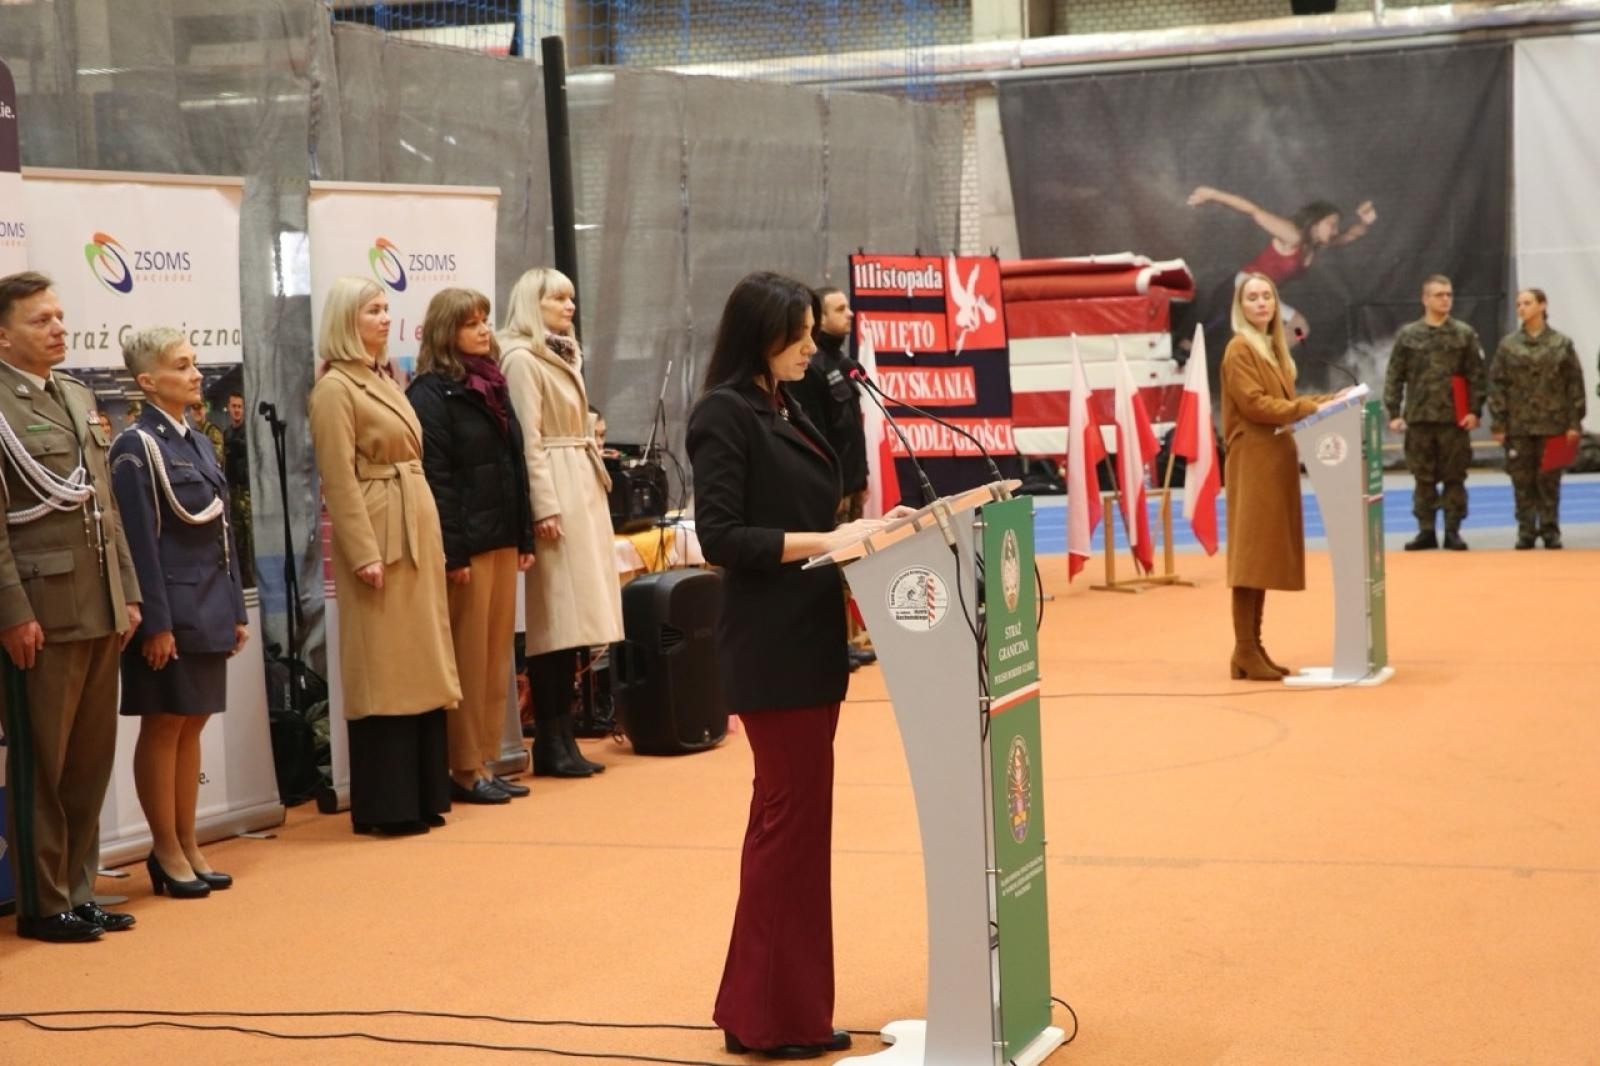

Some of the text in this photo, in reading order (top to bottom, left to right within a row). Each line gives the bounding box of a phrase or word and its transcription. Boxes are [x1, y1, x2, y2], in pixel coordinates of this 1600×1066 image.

[0, 221, 25, 238] OMS
[134, 250, 191, 271] ZSOMS
[409, 253, 457, 272] ZSOMS
[877, 371, 976, 399] DZYSKANIA
